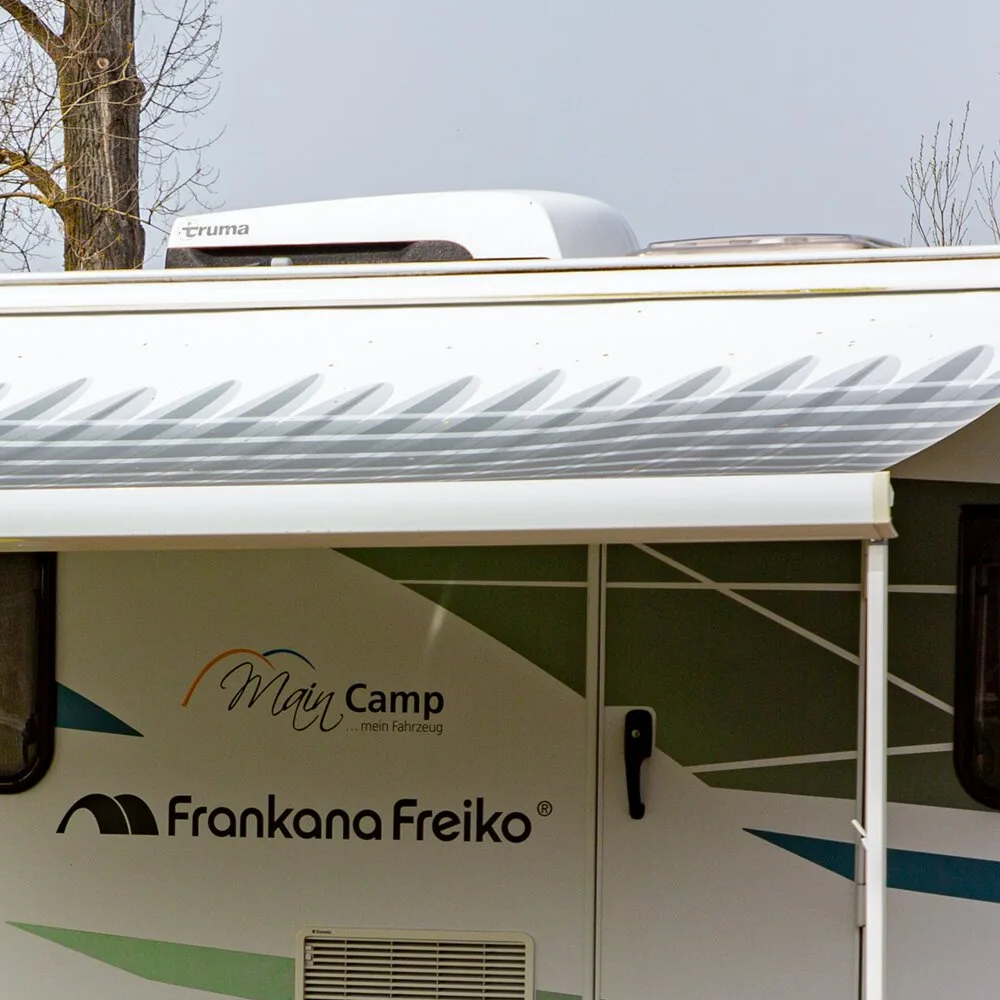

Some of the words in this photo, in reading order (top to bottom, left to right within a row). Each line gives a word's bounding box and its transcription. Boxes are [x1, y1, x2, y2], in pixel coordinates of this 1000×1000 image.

[182, 223, 250, 237] truma
[220, 661, 344, 732] Main
[345, 683, 445, 720] Camp
[391, 720, 443, 735] Fahrzeug
[168, 794, 382, 840] Frankana
